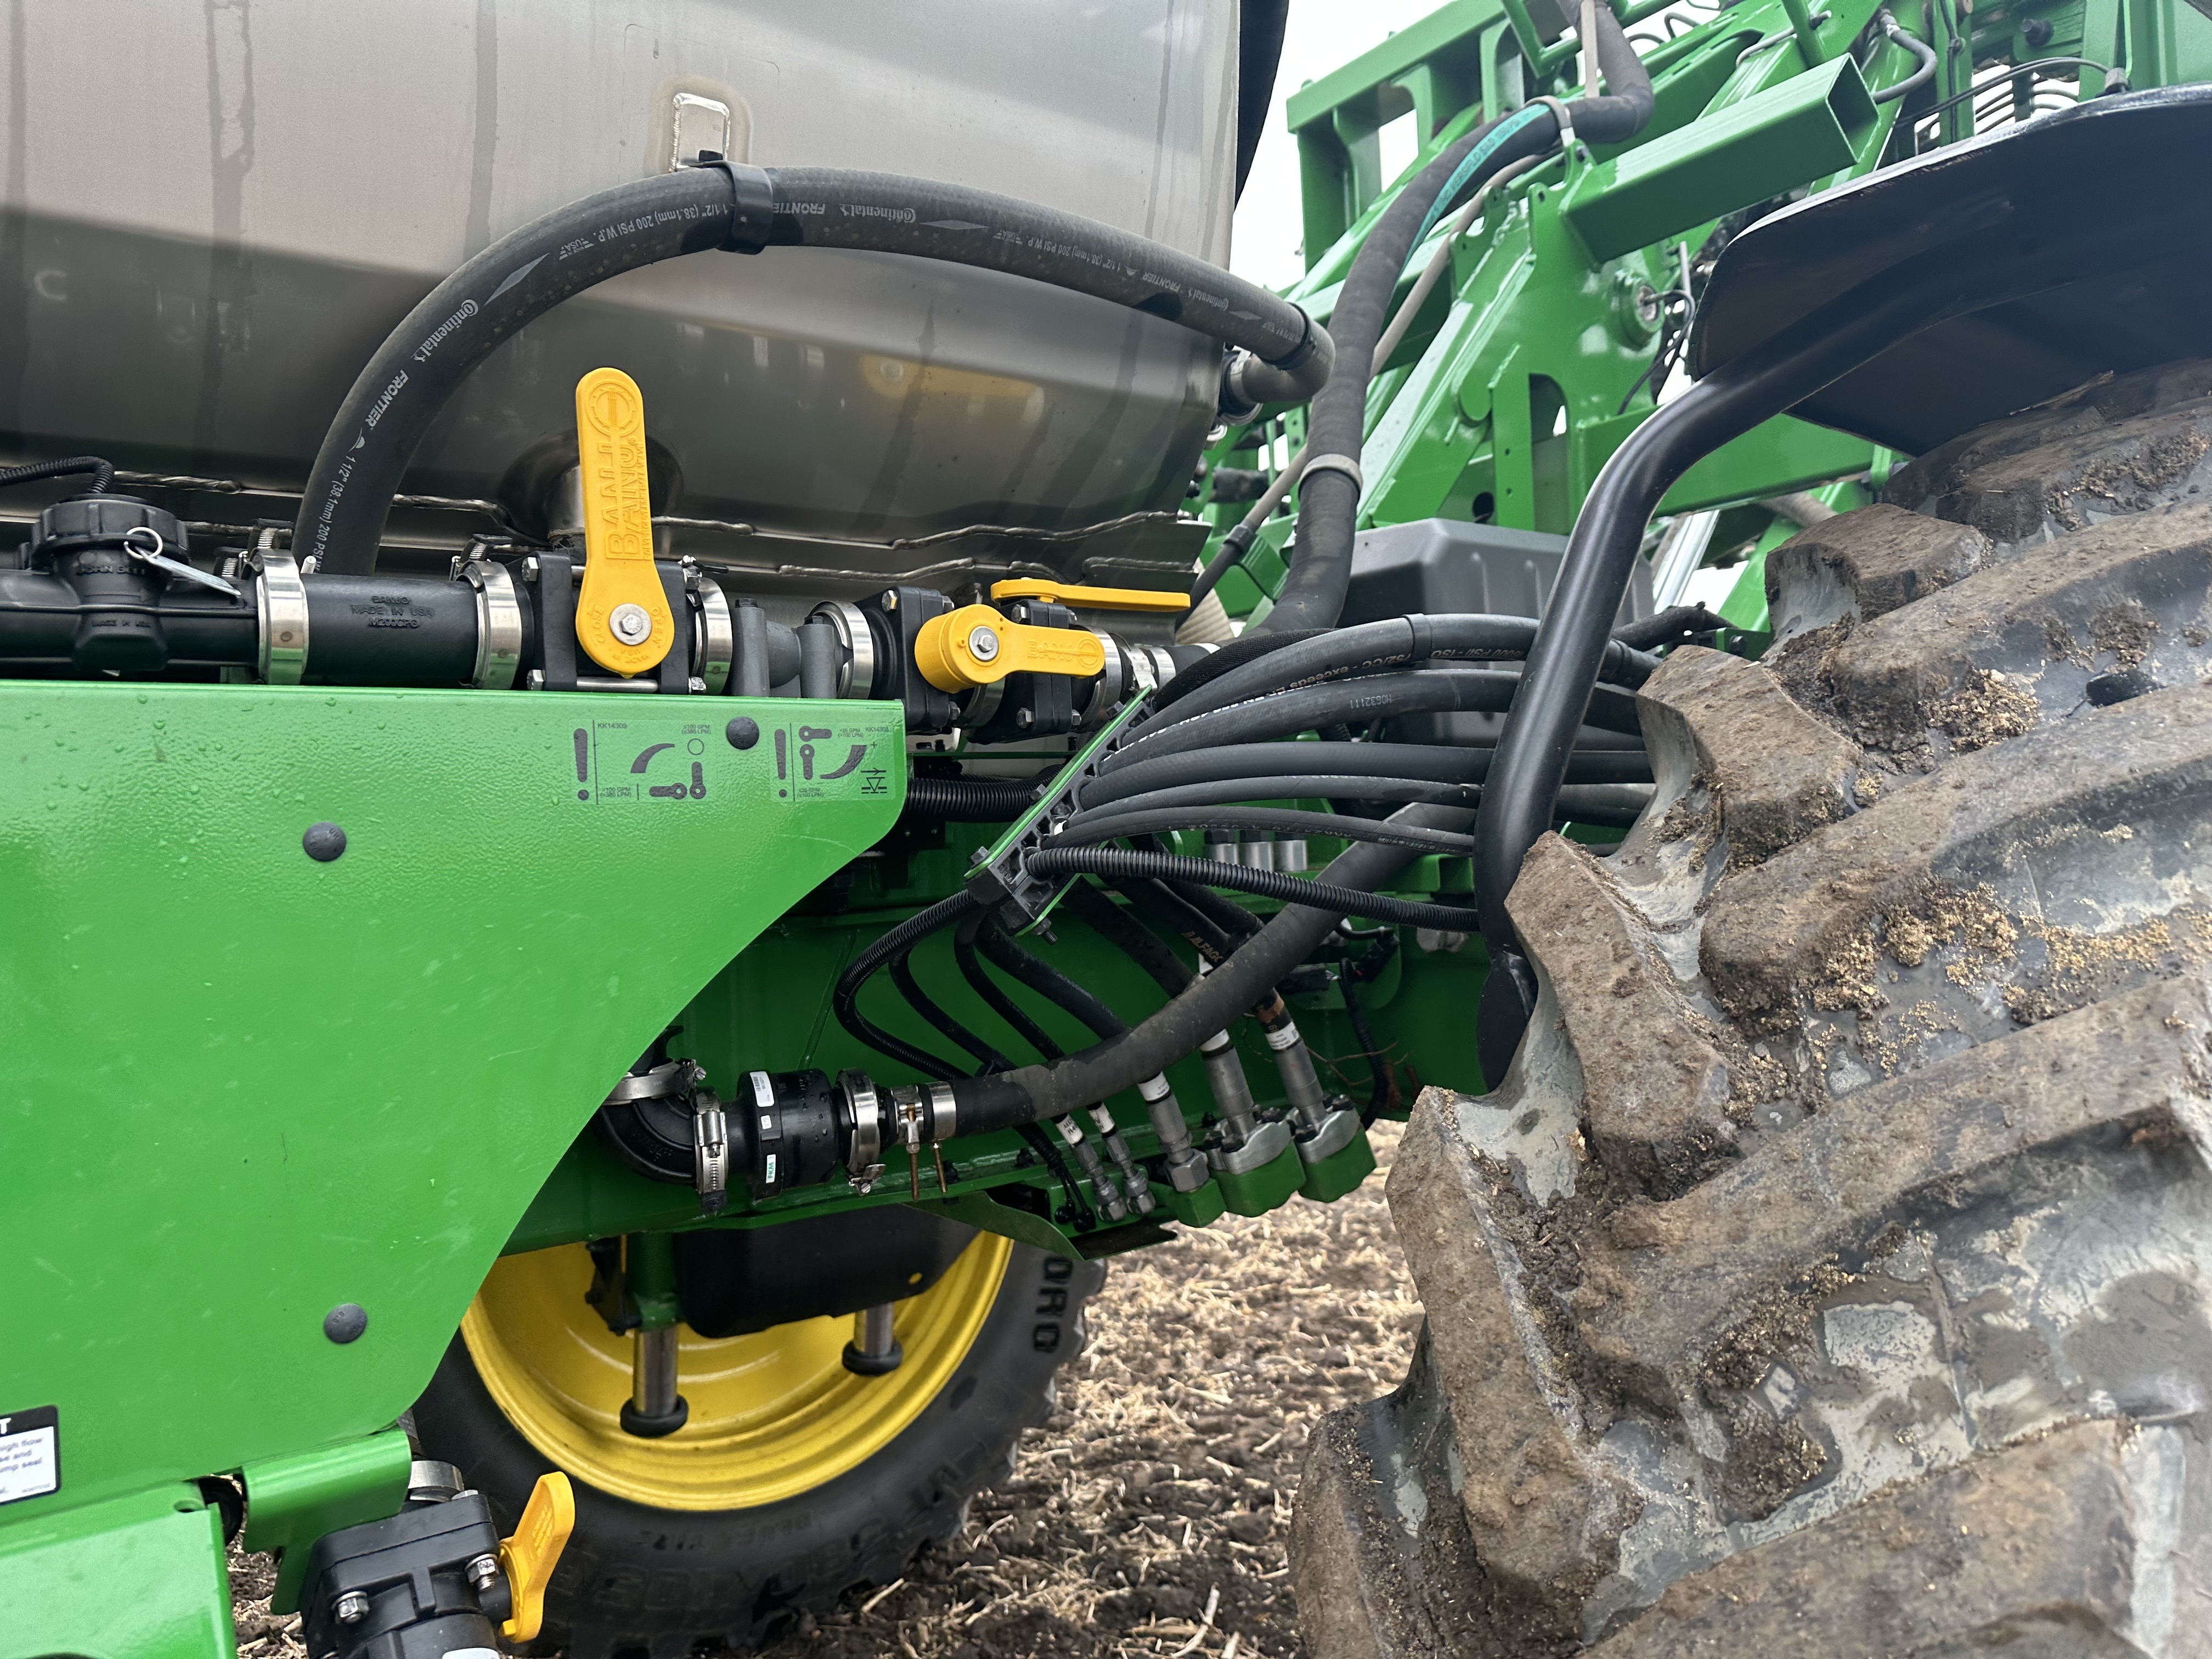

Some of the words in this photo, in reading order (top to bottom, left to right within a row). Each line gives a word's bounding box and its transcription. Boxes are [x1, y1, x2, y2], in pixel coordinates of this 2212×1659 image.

[654, 204, 699, 225] (38.1mm)
[772, 202, 826, 215] FRONTIE
[850, 204, 917, 223] Continental
[618, 221, 636, 237] PSI
[636, 215, 654, 230] 200
[1142, 272, 1181, 293] FRONTIER
[422, 299, 479, 357] Continental
[365, 369, 409, 428] FRONTIER
[319, 480, 345, 523] (38.1mm)
[316, 523, 330, 541] 200
[371, 596, 410, 604] BANJO
[351, 605, 385, 615] MADE
[391, 606, 404, 616] IN
[411, 607, 434, 617] USA
[592, 605, 605, 644] CLOSE
[650, 607, 663, 645] OPEN
[1289, 666, 1349, 689] exceeds
